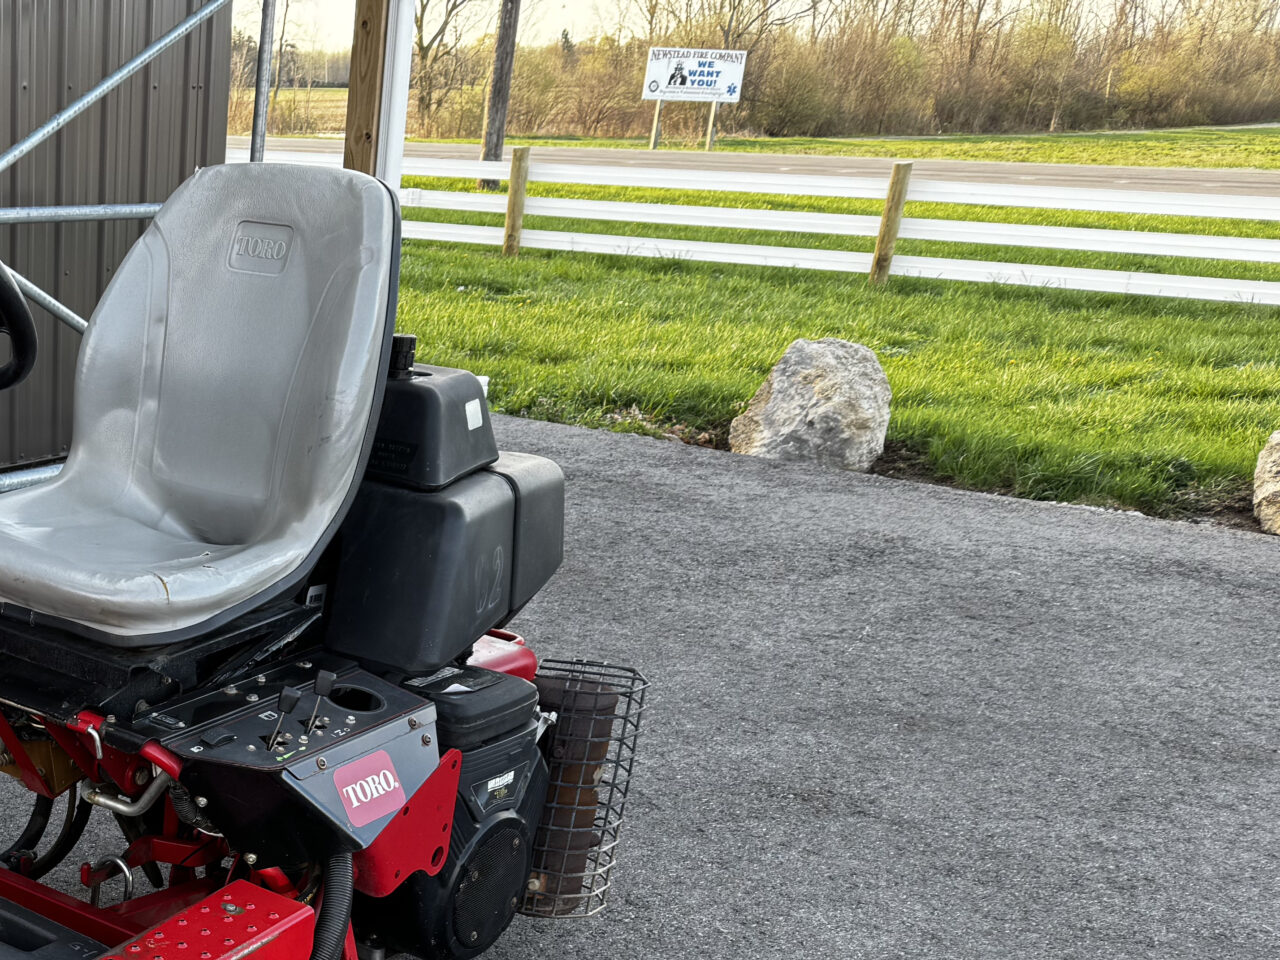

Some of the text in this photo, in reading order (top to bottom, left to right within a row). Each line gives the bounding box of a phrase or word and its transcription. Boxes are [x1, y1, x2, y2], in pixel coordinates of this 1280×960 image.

[651, 49, 745, 64] NEWSTEAD FIRE COMPANY
[697, 60, 715, 68] WE
[688, 69, 721, 78] WANT
[690, 79, 717, 88] YOU!
[236, 236, 286, 260] TORO
